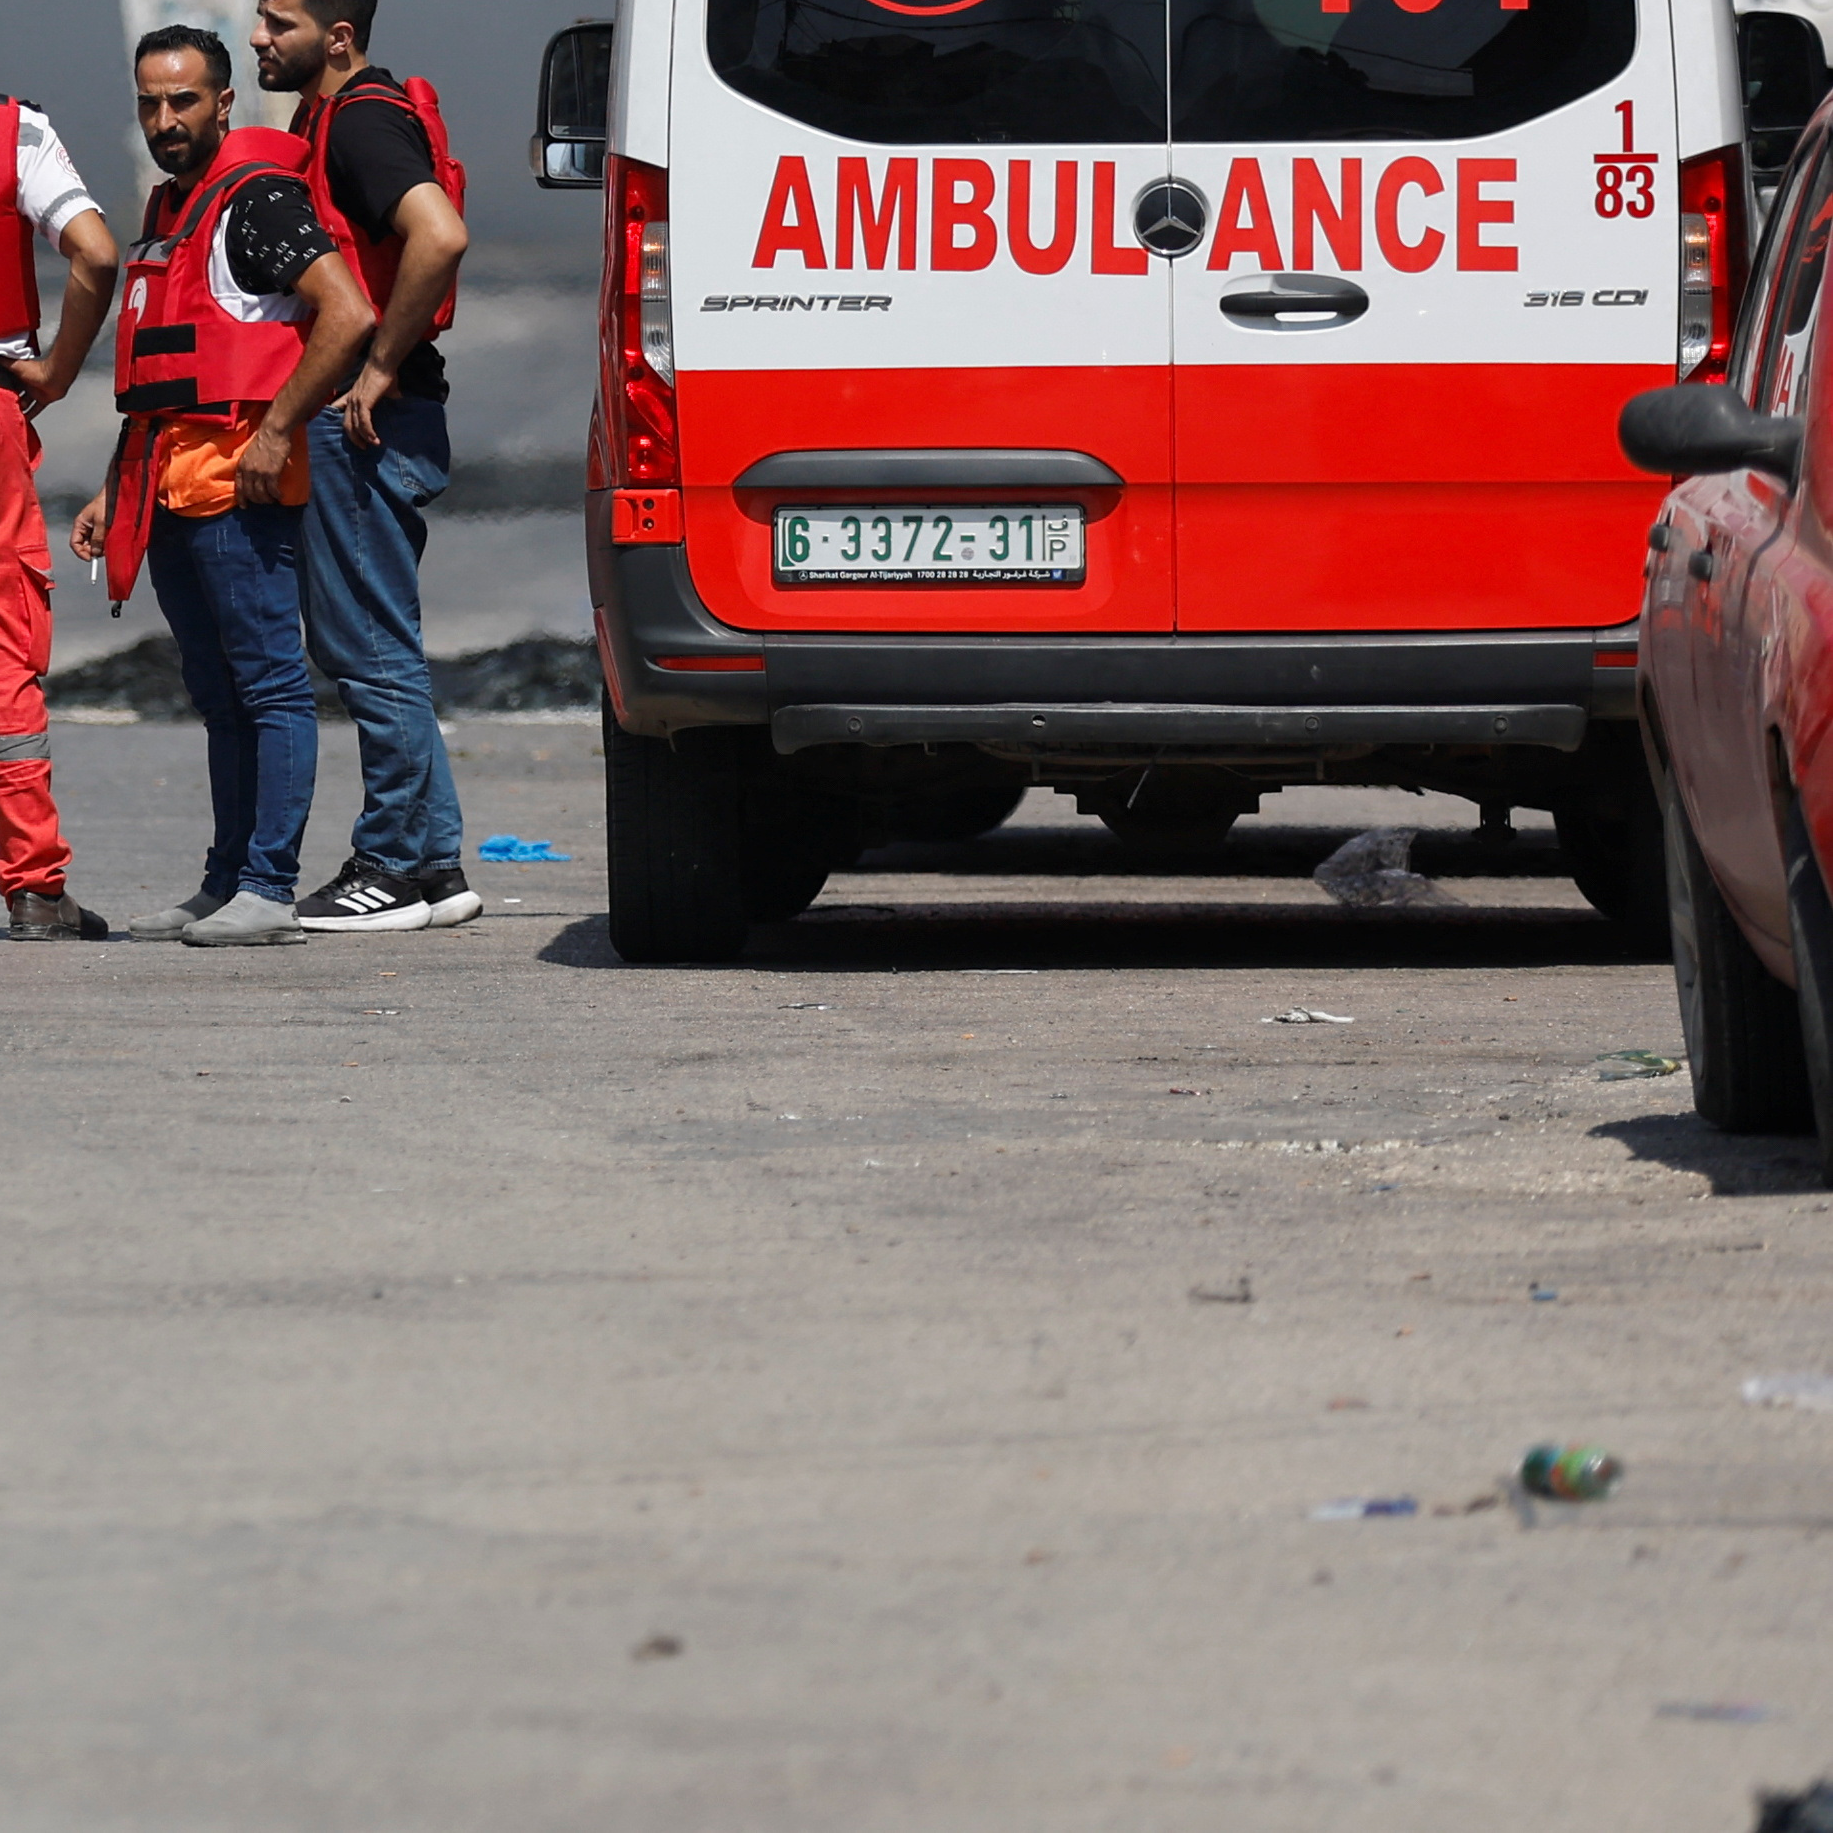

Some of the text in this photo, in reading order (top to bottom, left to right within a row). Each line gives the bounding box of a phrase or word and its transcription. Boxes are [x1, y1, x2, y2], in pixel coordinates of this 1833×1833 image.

[1614, 99, 1634, 153] 1
[1594, 164, 1656, 219] 83
[699, 294, 893, 312] SPRINTER
[1592, 289, 1650, 308] CDI
[1048, 538, 1067, 561] P
[809, 570, 839, 580] Sharikat
[839, 571, 868, 581] Gargour
[917, 570, 936, 579] 1700
[936, 570, 947, 579] 28
[947, 570, 958, 579] 28
[959, 570, 970, 579] 28
